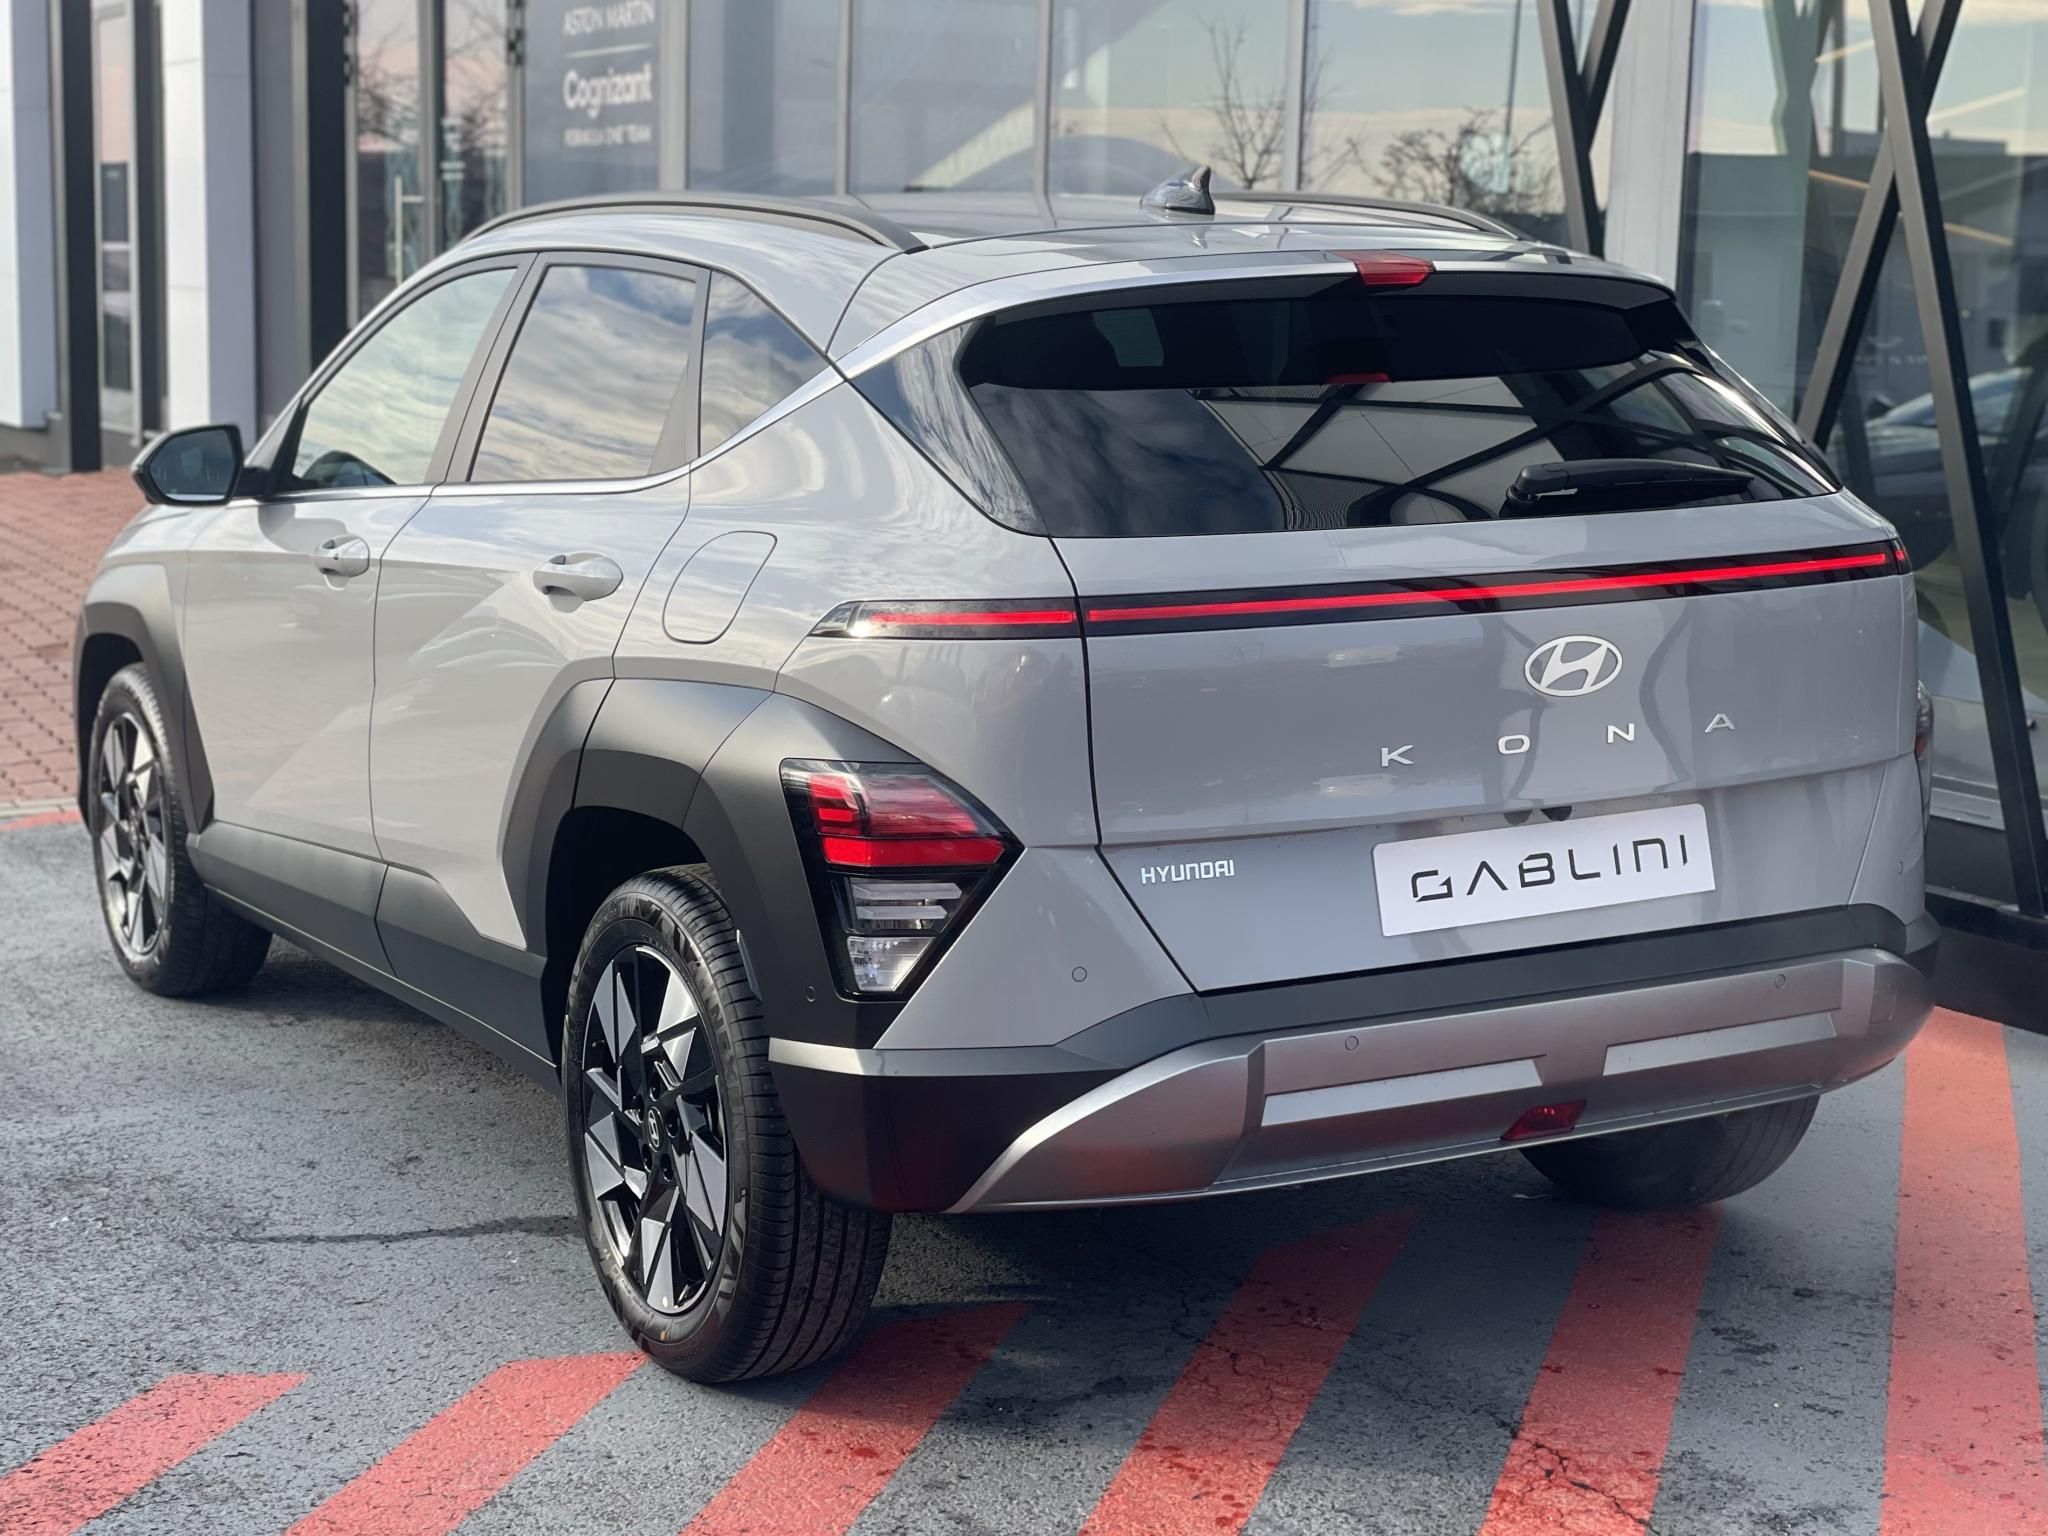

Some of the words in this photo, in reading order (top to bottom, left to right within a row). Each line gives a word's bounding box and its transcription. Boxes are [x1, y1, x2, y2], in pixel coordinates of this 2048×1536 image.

[563, 62, 652, 119] Cognizant
[1380, 712, 1735, 767] KONA
[1140, 859, 1235, 885] HYUNDAI
[1410, 833, 1688, 903] GABLINI
